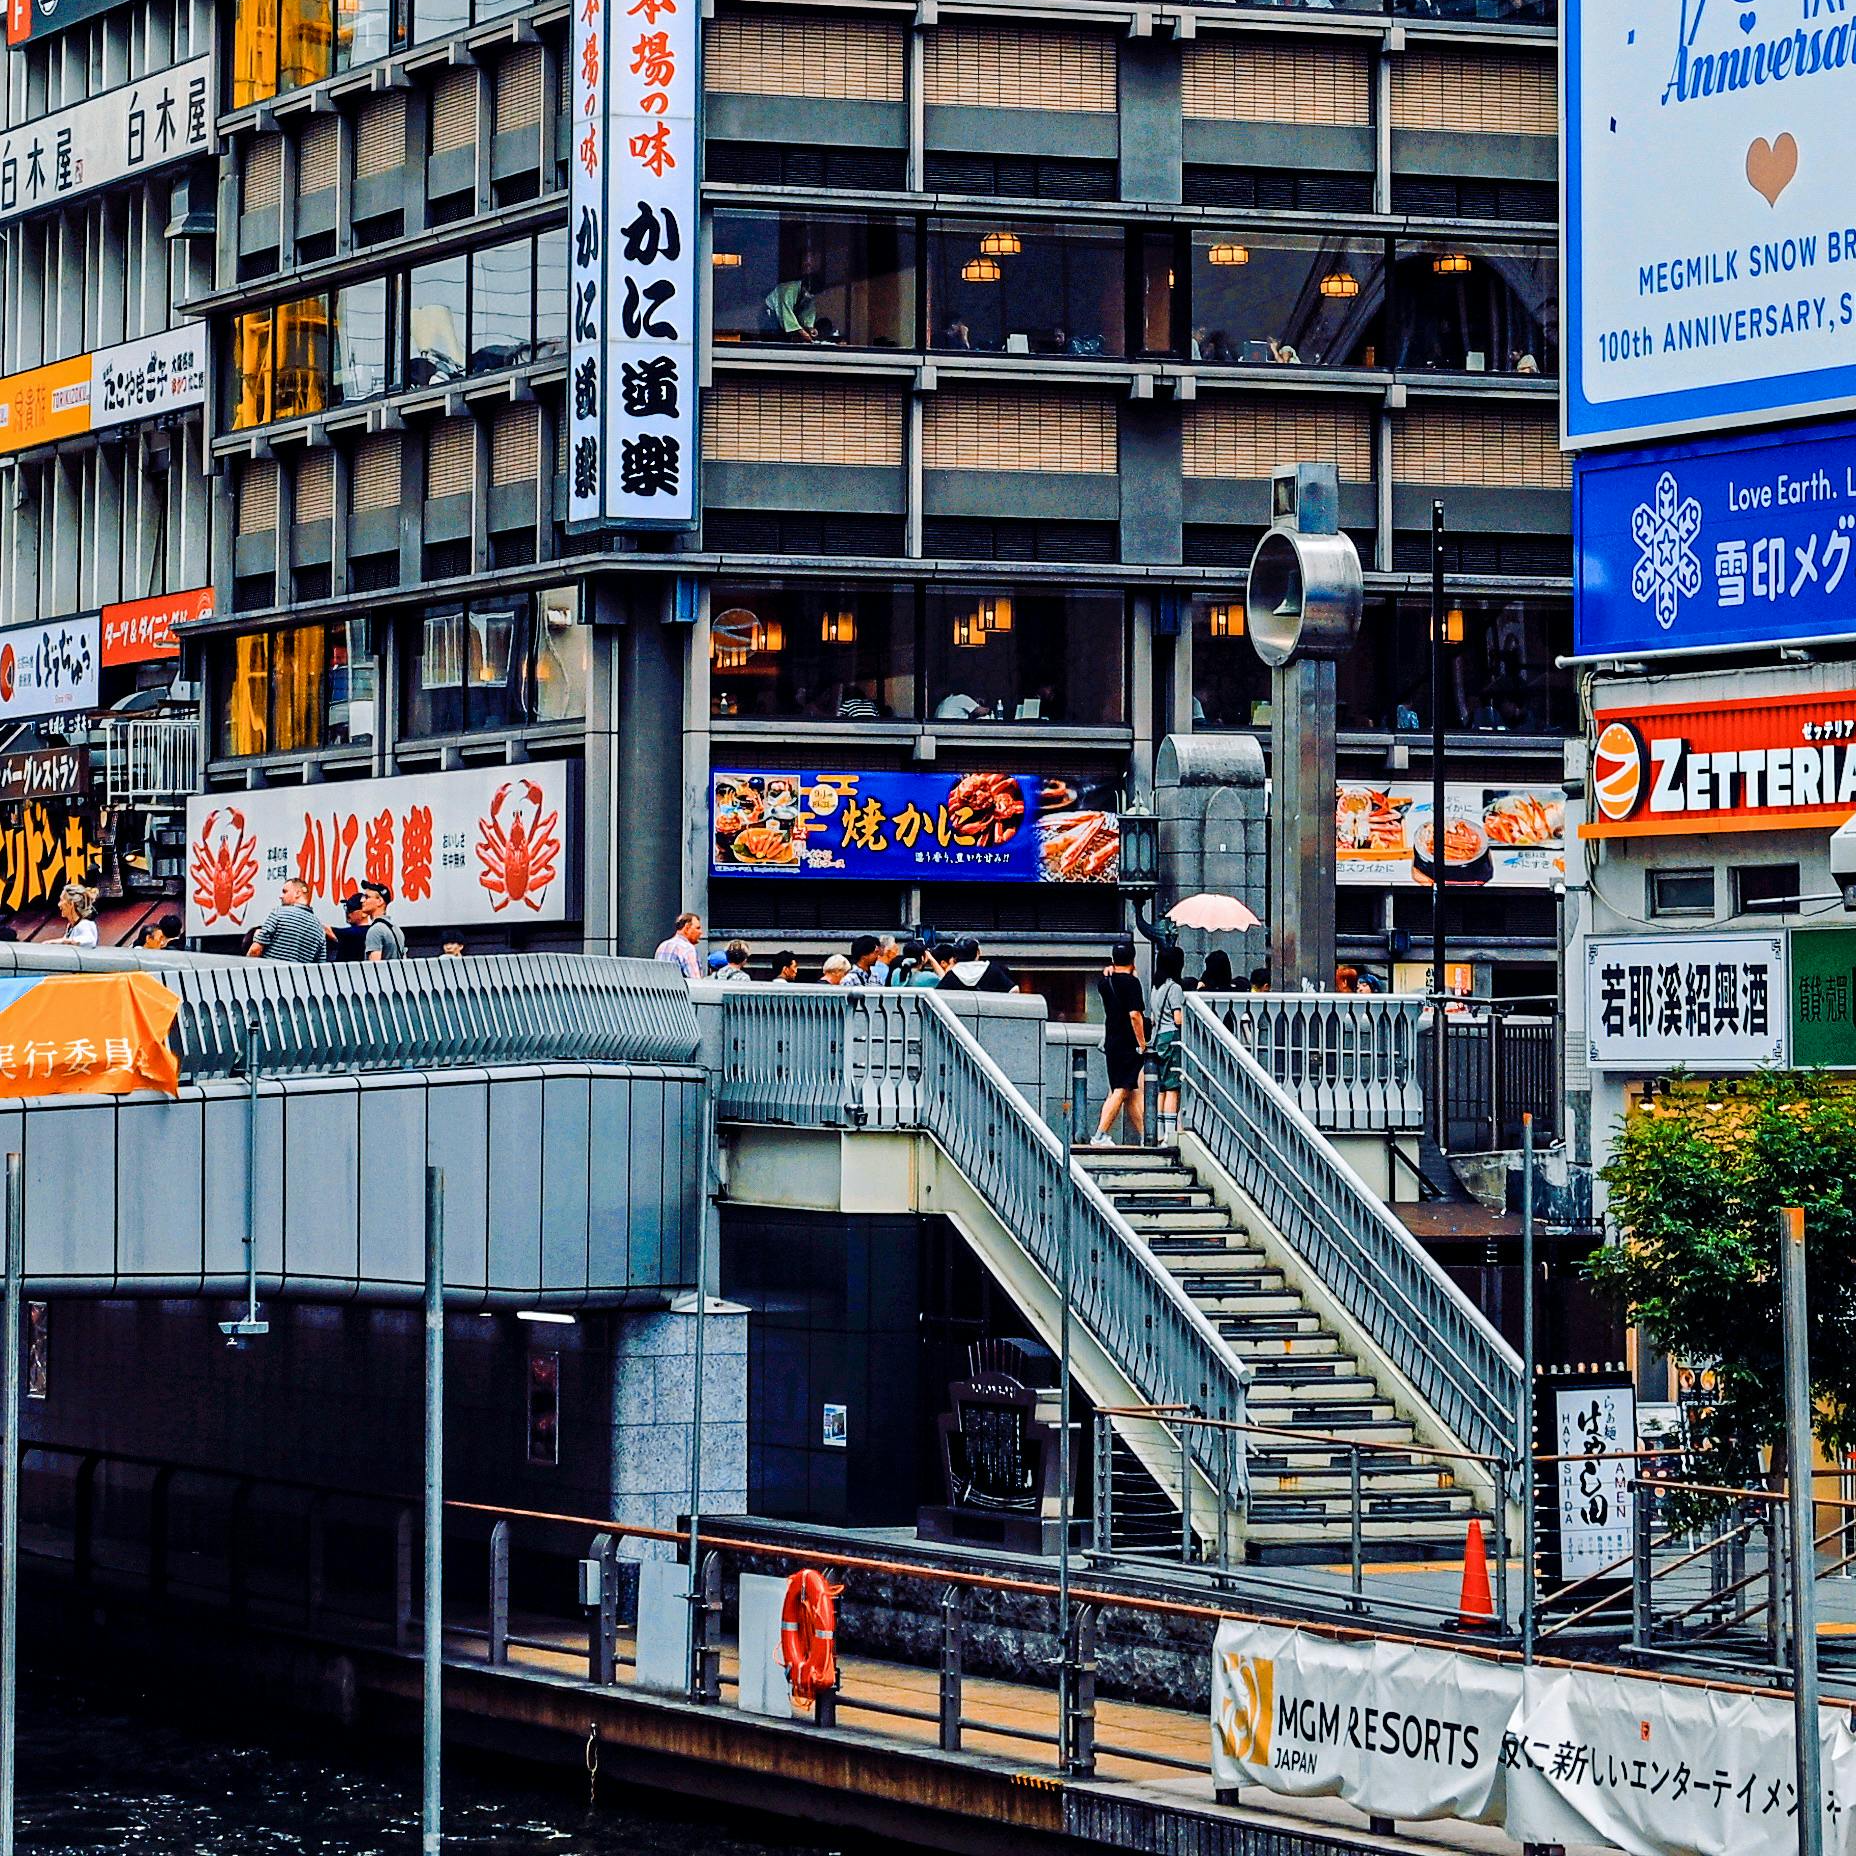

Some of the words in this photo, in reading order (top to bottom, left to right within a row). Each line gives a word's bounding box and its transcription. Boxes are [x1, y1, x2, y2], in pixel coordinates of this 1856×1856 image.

[1, 128, 72, 210] 白木屋
[128, 77, 207, 167] 白木屋
[1639, 250, 1738, 296] MEGMILK
[1749, 232, 1816, 276] SNOW
[1599, 318, 1653, 363] 100th
[1728, 481, 1771, 511] Love
[1777, 472, 1837, 505] Earth.
[1802, 720, 1855, 740] ゼッテリア
[842, 798, 975, 851] 焼かに
[1562, 1414, 1573, 1524] HAYSHIDA
[1279, 1695, 1339, 1744] MGM
[1347, 1706, 1480, 1770] RESORTS
[1274, 1747, 1317, 1776] JAPAN
